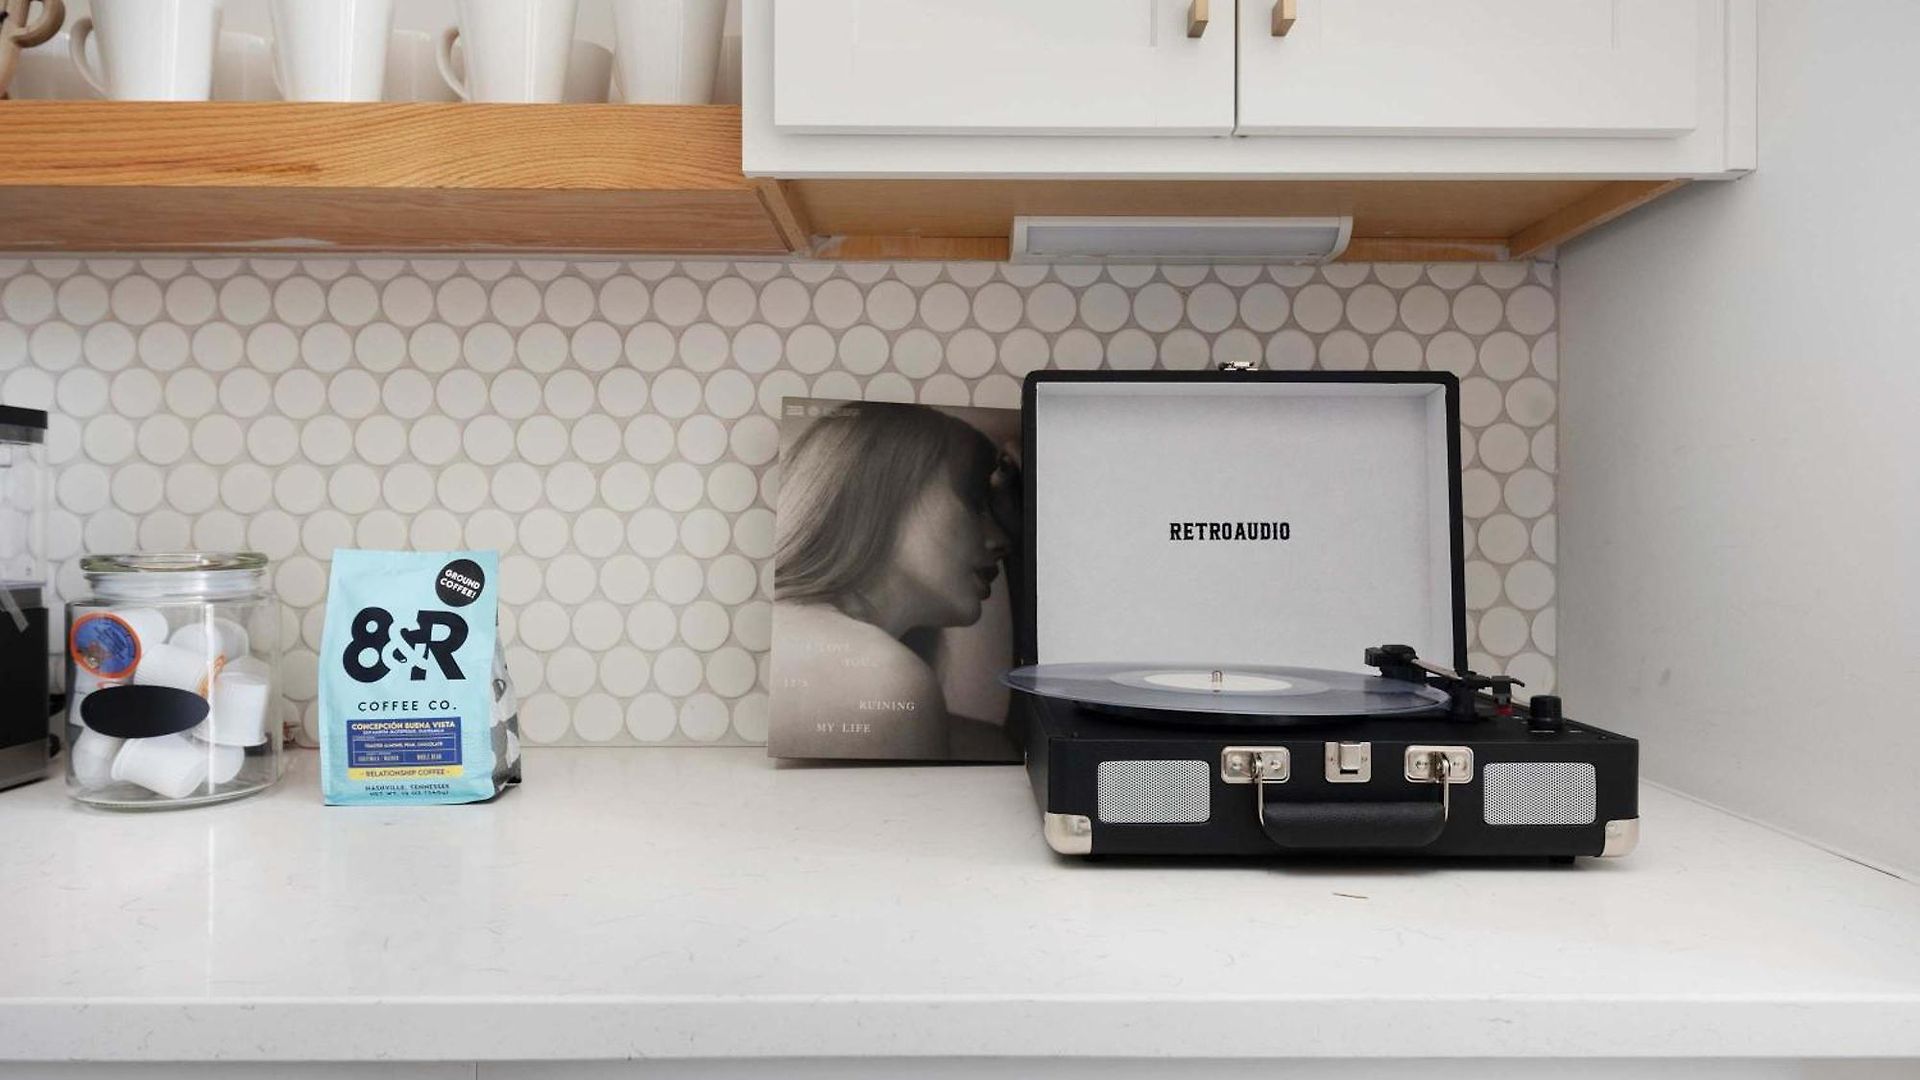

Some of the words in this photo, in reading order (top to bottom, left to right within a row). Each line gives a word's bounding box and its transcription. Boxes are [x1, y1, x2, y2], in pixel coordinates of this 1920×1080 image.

[1169, 522, 1290, 540] RETROAUDIO
[445, 569, 480, 590] GROUND
[439, 578, 477, 599] COFFEE!
[357, 700, 419, 712] COFFEE
[428, 700, 457, 711] CO.
[859, 700, 916, 711] RUINING
[351, 721, 403, 731] CONCEPCIÓN
[404, 721, 431, 730] BUENA
[432, 720, 456, 729] VISTA
[816, 722, 835, 733] MY
[842, 722, 872, 733] LIFE
